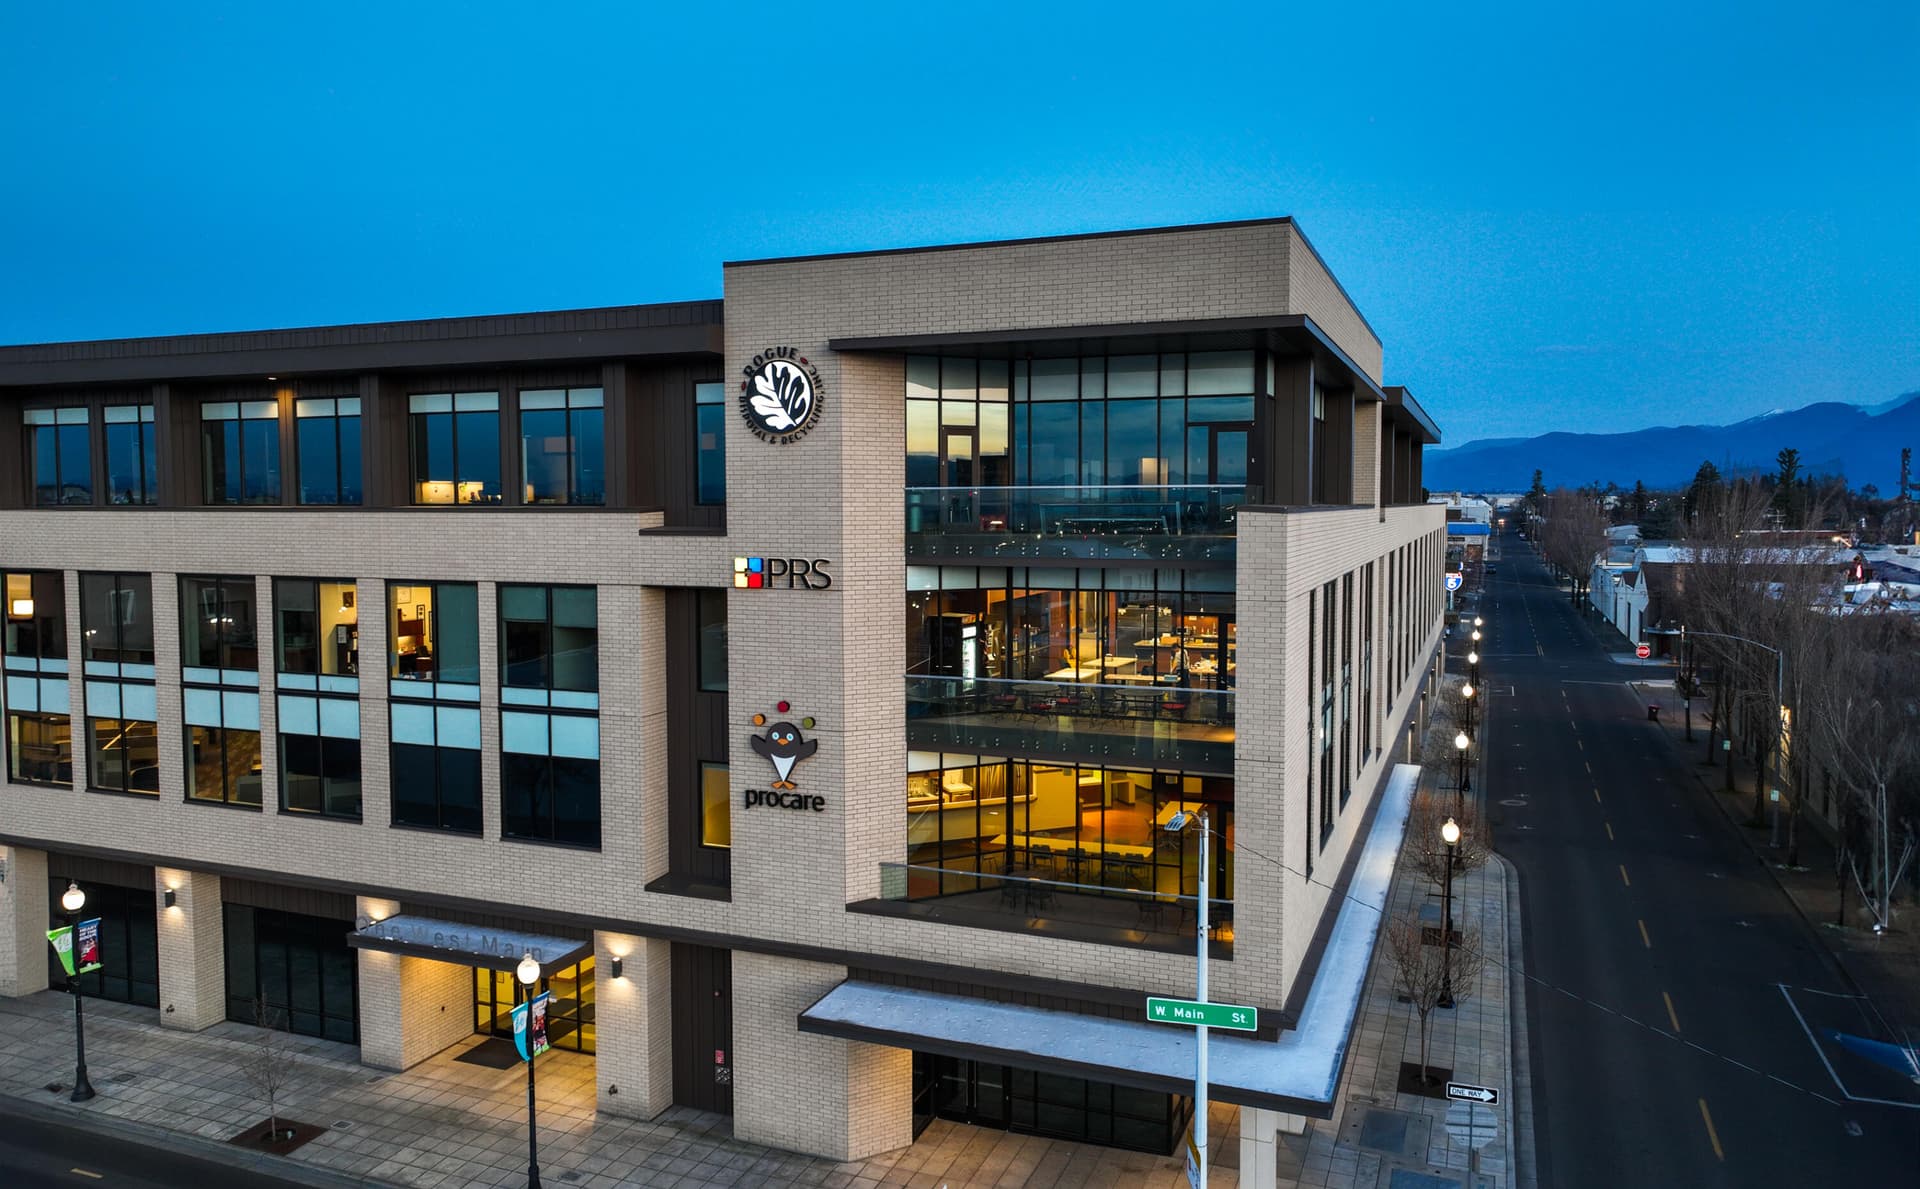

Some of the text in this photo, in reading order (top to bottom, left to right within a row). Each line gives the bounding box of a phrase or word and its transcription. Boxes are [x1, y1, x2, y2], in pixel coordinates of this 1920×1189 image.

[743, 346, 799, 378] ROGUE
[739, 396, 766, 443] DISPOSAL
[769, 436, 777, 444] &
[767, 558, 832, 589] PRS
[744, 789, 825, 812] procare
[1174, 1007, 1205, 1020] Main
[1451, 1087, 1464, 1095] ONE
